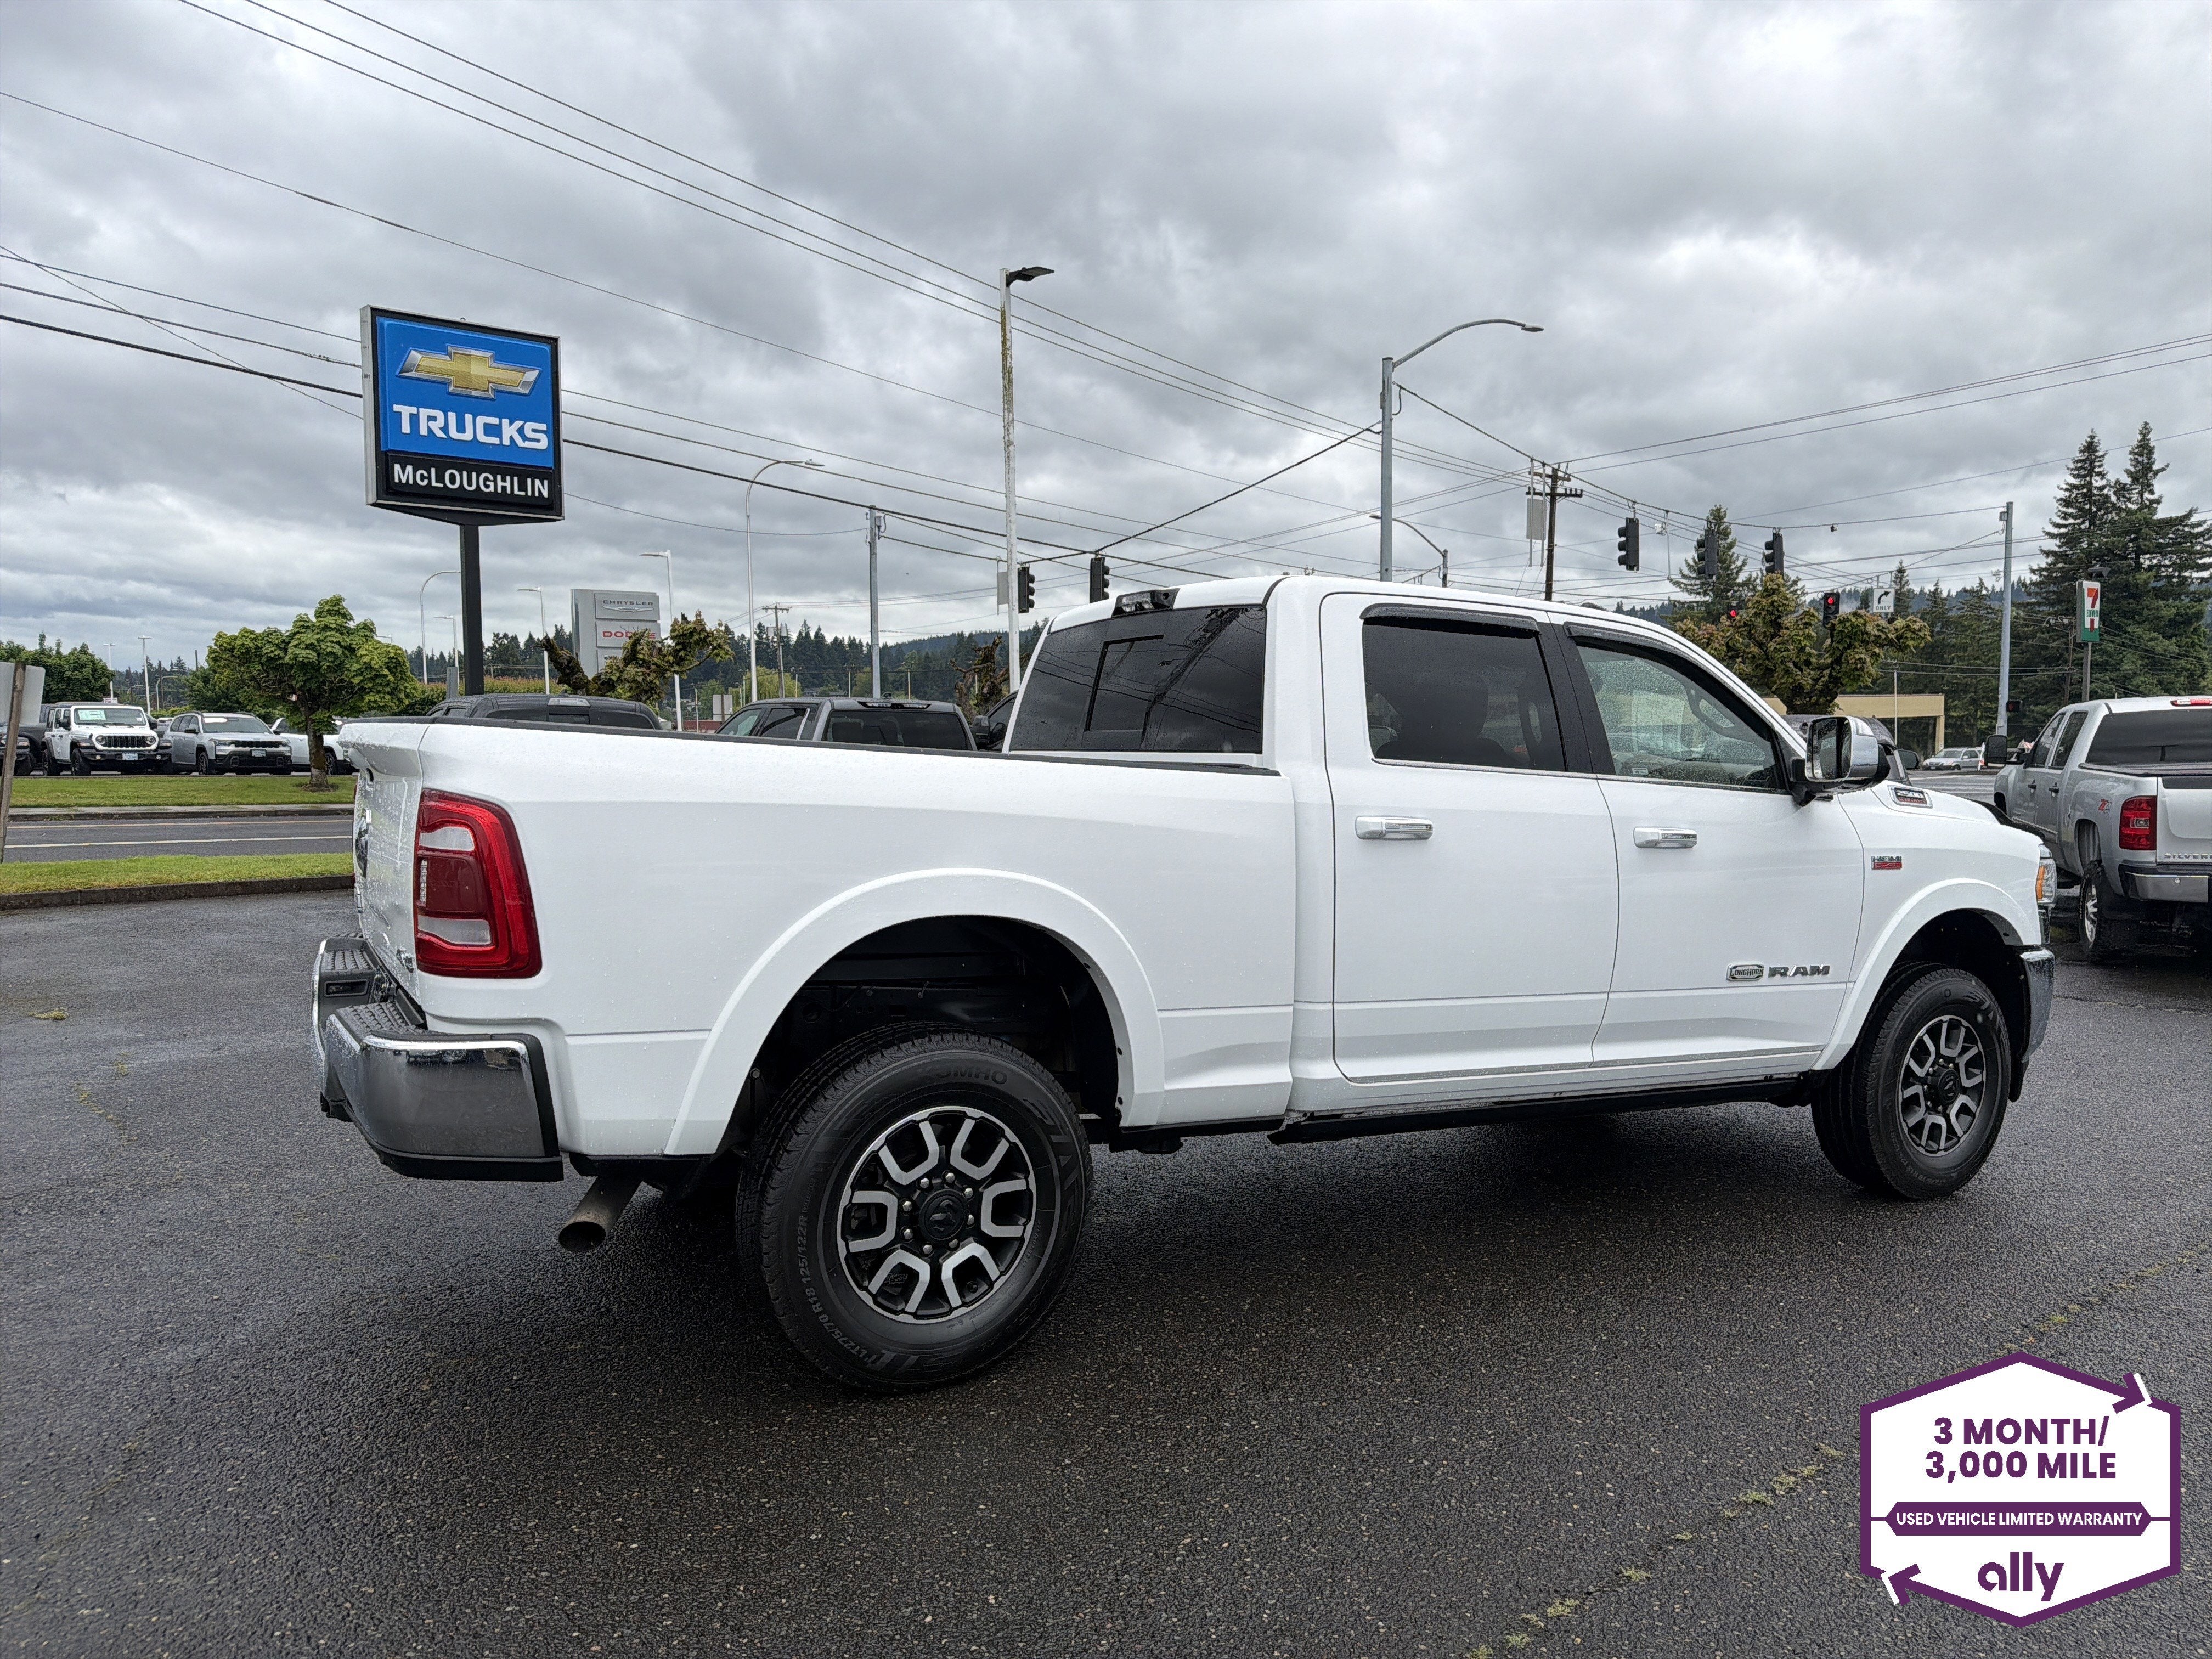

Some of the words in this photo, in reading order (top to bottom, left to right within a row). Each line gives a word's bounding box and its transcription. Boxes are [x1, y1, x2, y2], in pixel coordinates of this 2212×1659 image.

[393, 404, 548, 450] TRUCKS
[393, 464, 548, 498] McLOUGHLIN
[602, 630, 656, 639] DODE
[1768, 964, 1830, 978] RAM
